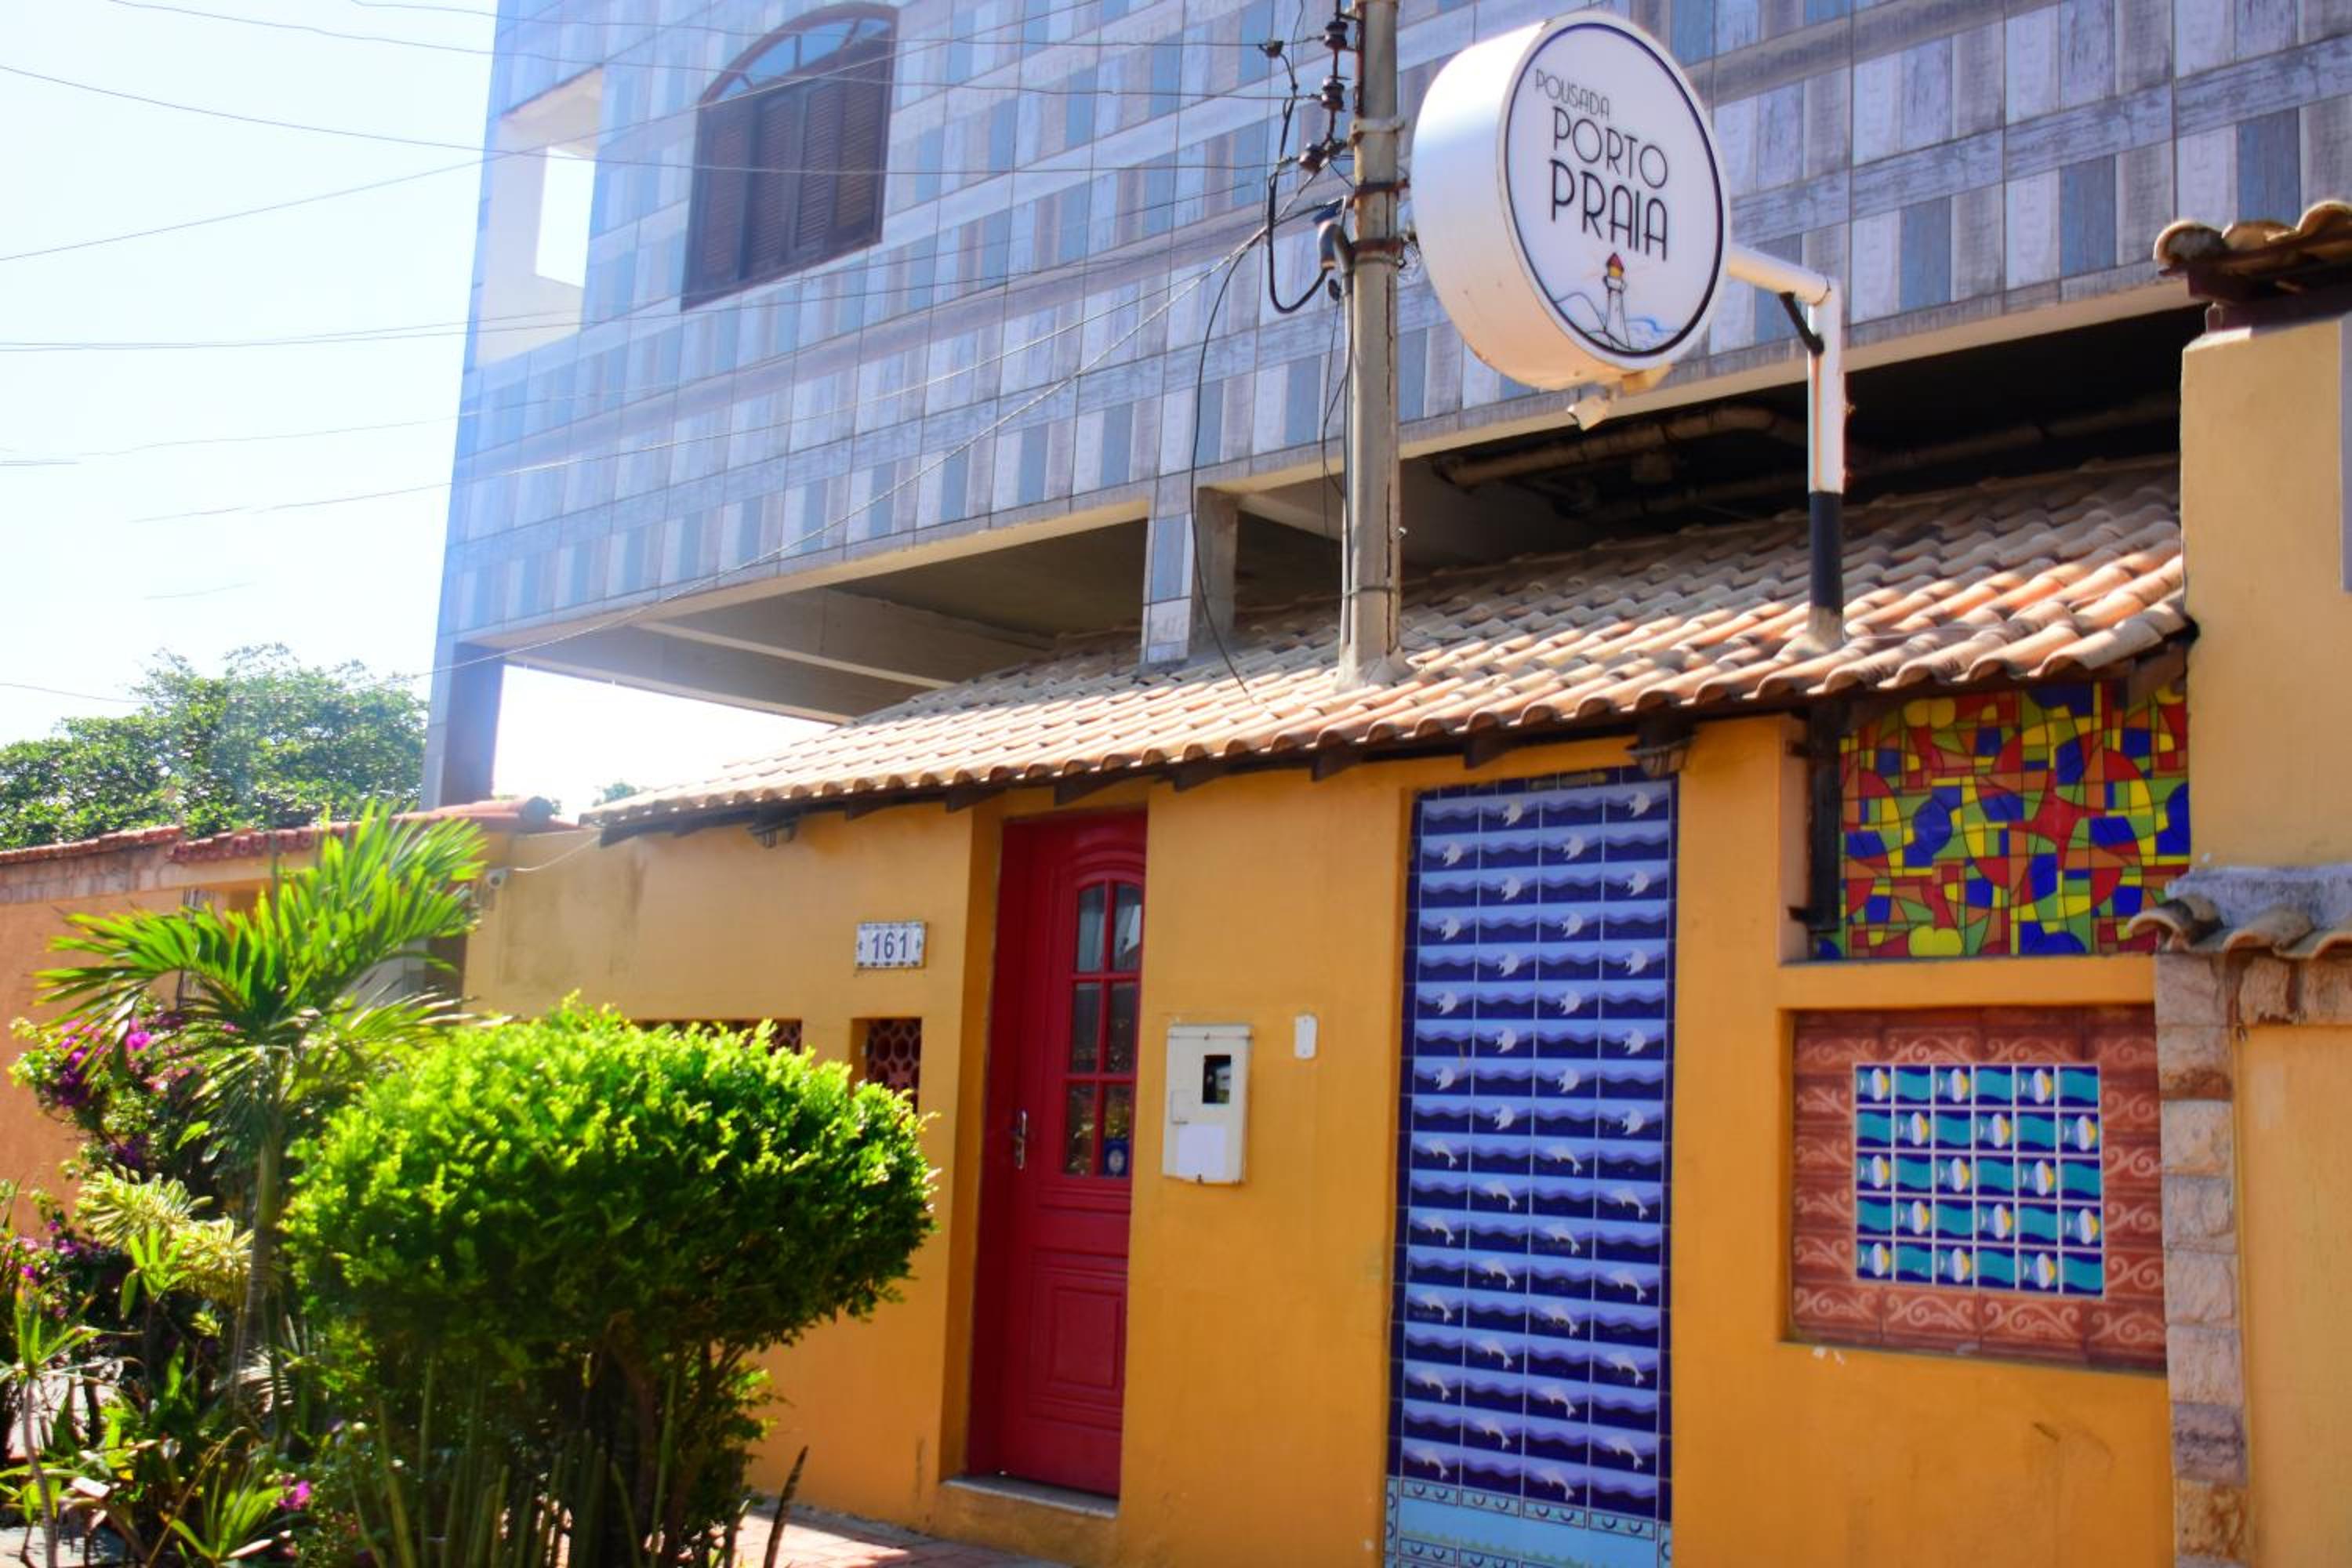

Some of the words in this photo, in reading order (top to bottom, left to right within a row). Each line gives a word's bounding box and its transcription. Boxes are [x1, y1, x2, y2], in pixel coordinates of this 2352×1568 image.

[1535, 68, 1609, 119] POUSADA
[1552, 106, 1668, 189] PORTO
[1549, 158, 1668, 262] PRAIA
[872, 931, 908, 960] 161
